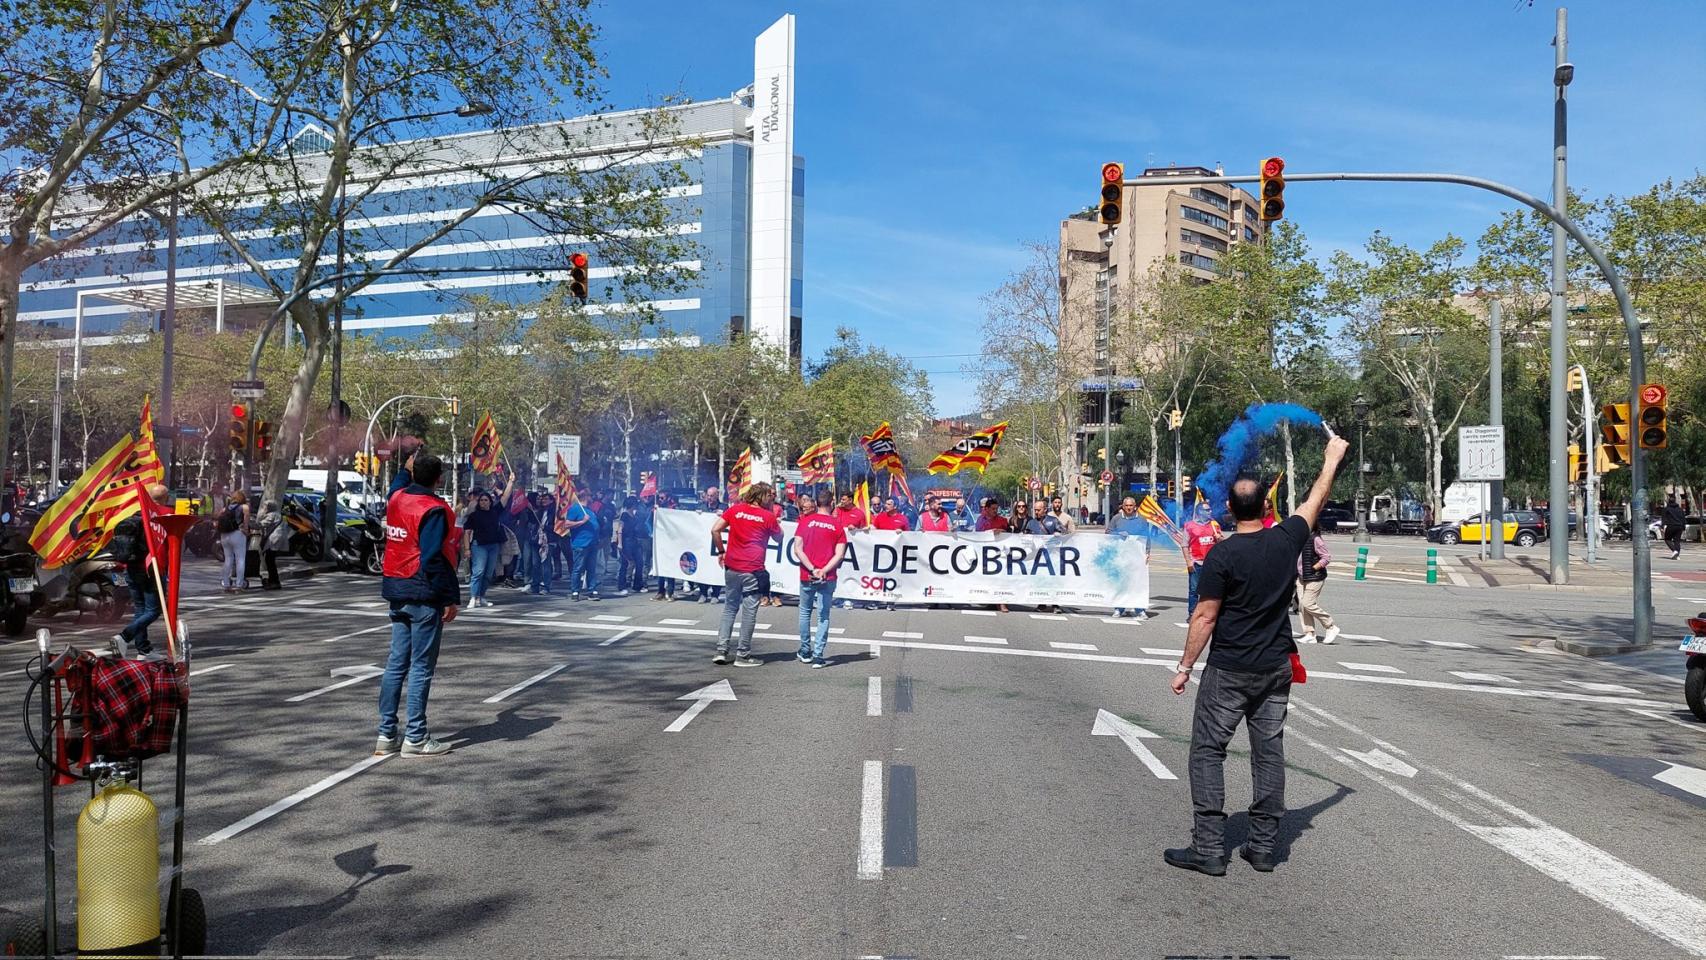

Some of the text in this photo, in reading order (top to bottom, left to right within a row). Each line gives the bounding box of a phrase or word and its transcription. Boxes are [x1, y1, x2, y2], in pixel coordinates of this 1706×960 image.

[770, 72, 779, 132] DIAGONAL
[762, 115, 770, 143] ALTA
[872, 544, 919, 574] DE
[928, 544, 1081, 577] COBRAR
[860, 575, 897, 593] sap
